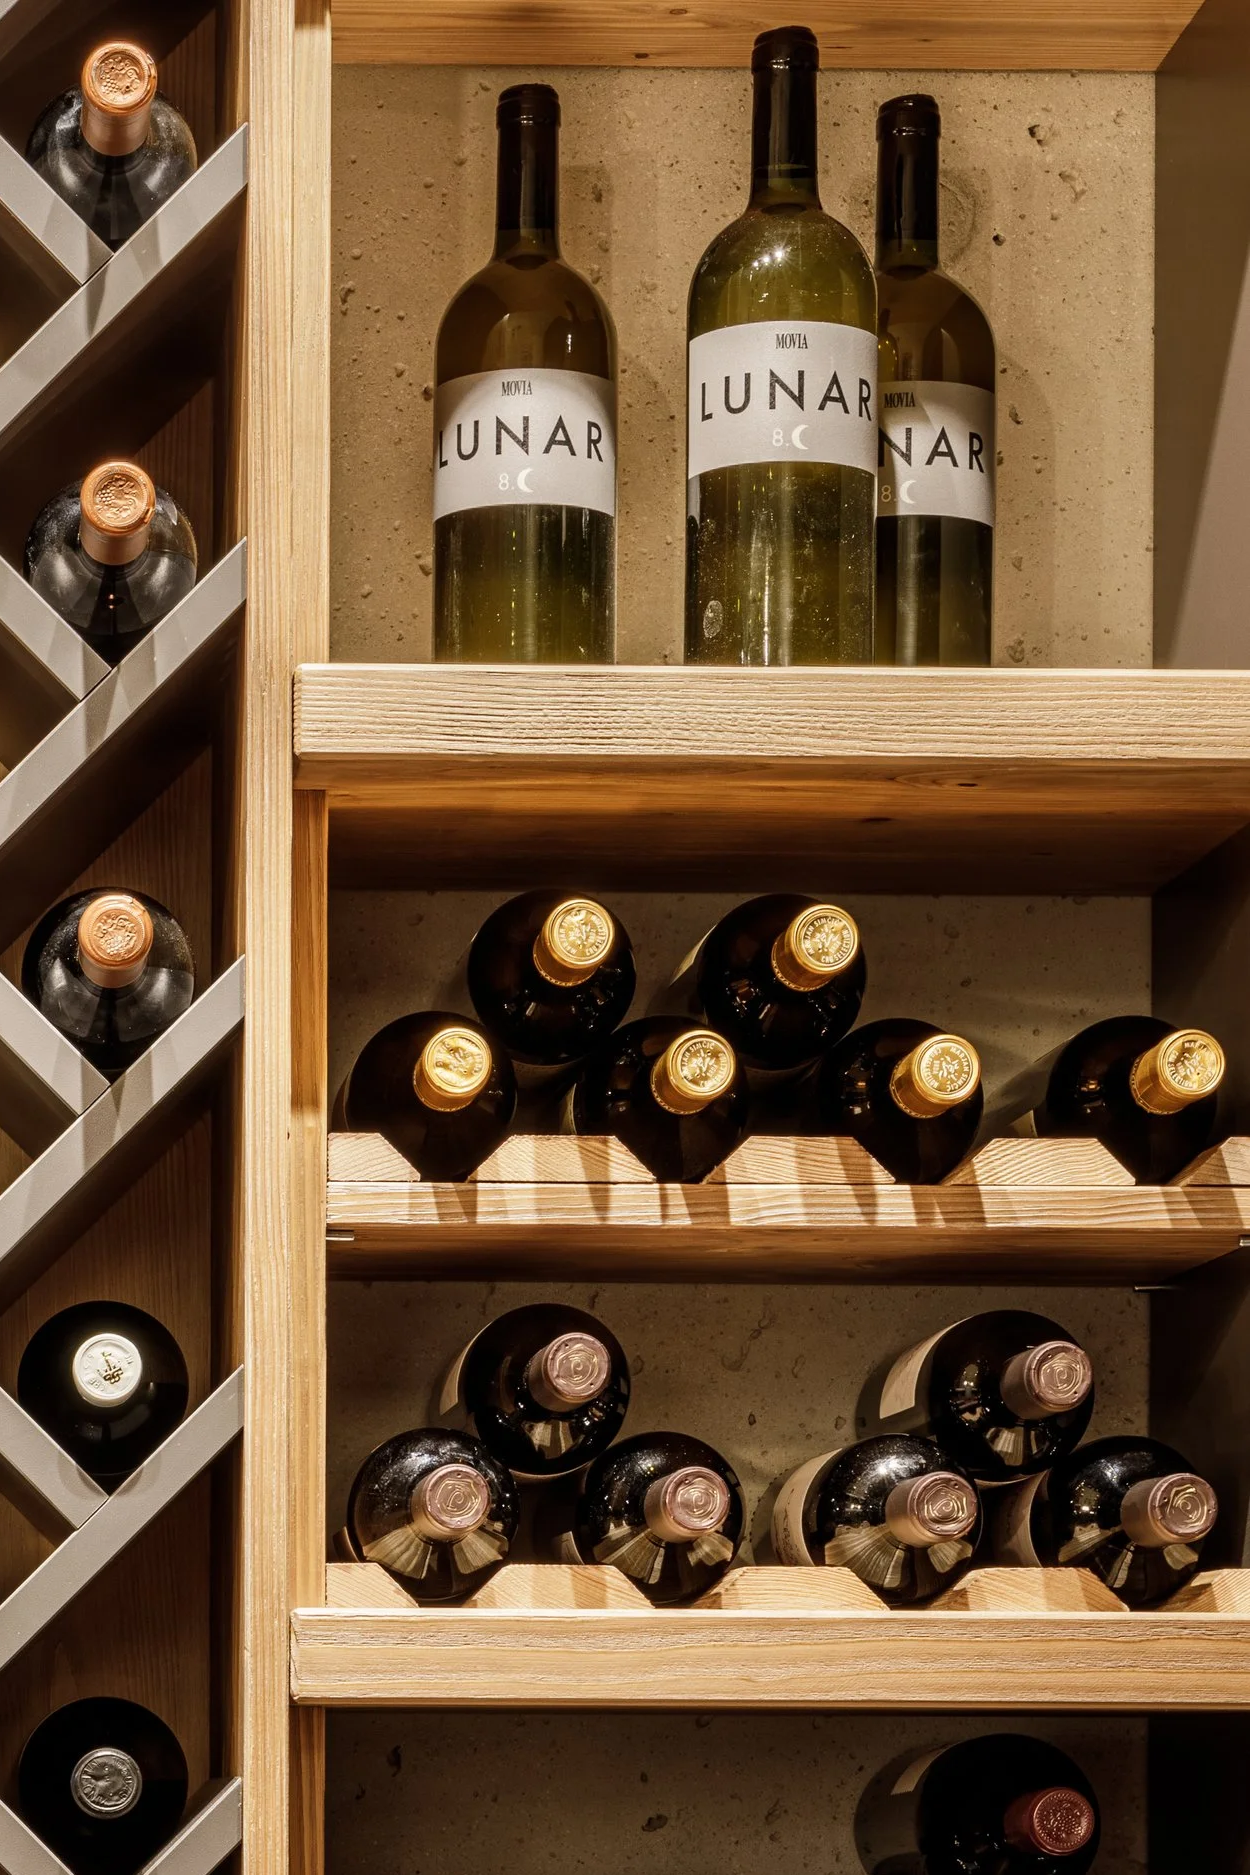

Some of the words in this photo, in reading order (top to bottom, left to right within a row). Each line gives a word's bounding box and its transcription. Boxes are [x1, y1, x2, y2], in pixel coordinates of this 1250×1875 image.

[775, 333, 809, 349] MOVIA
[501, 380, 533, 396] MOVIA
[701, 368, 872, 422] LUNAR
[884, 392, 916, 408] MOVIA
[439, 414, 604, 469] LUNAR
[878, 426, 985, 474] NAR
[950, 1046, 969, 1072] MARJAN
